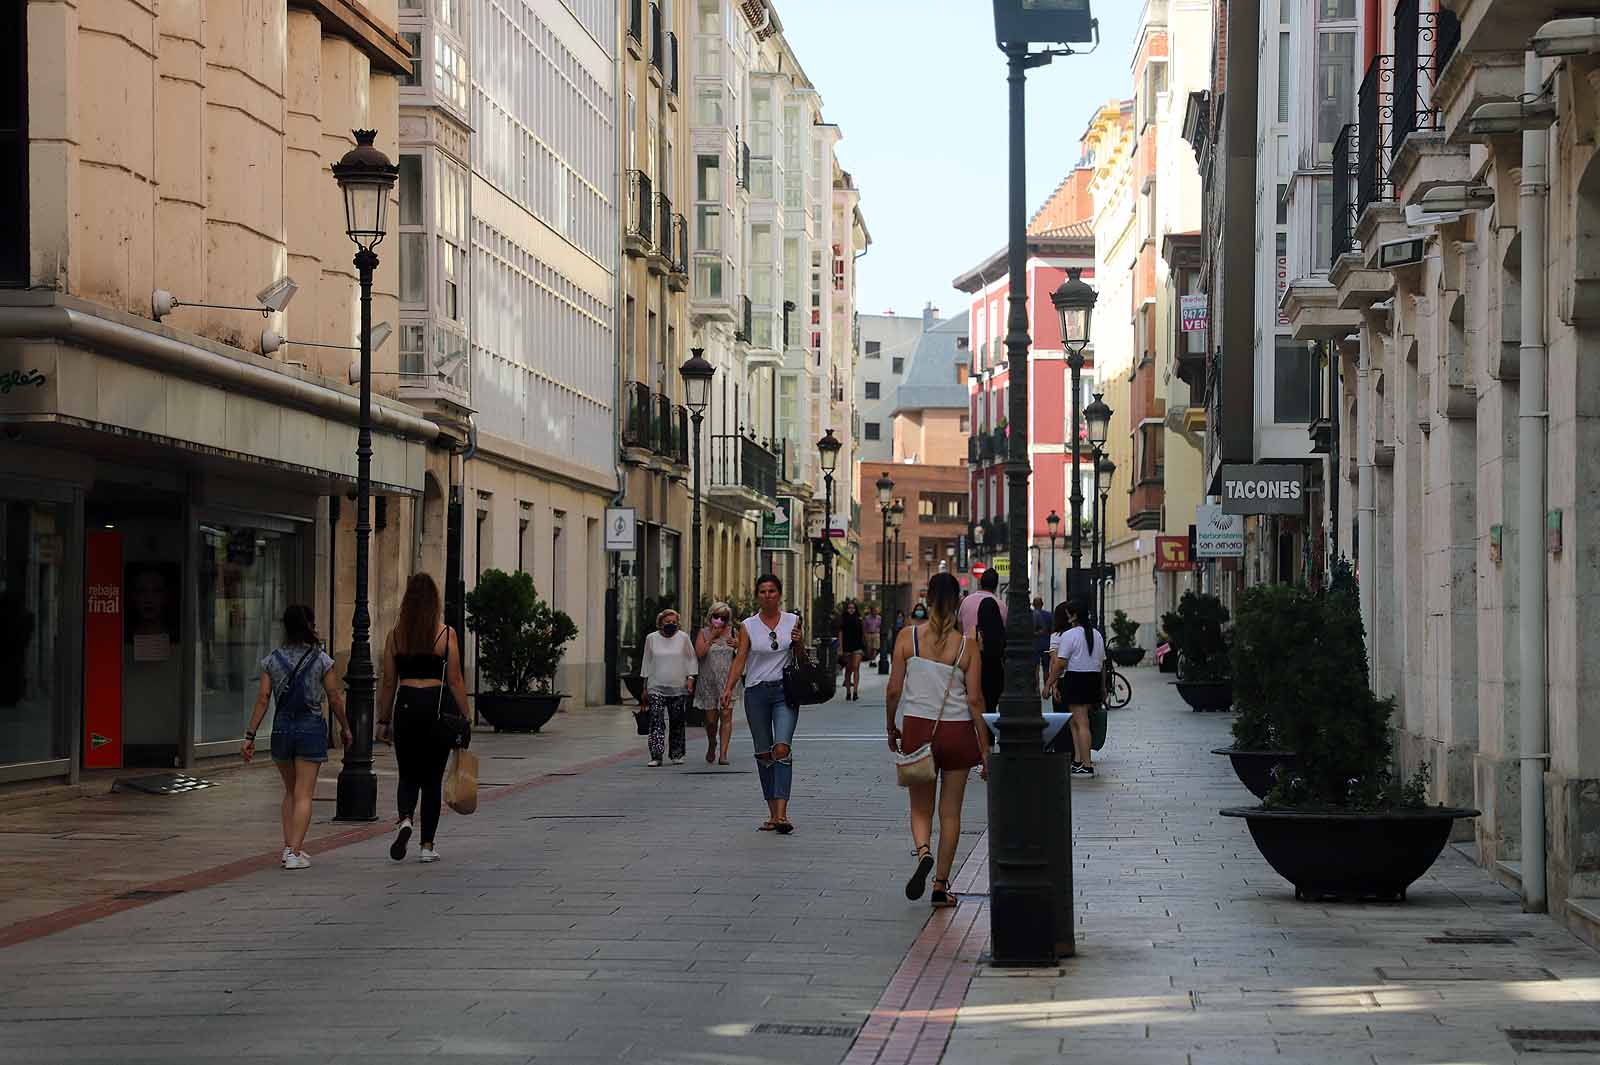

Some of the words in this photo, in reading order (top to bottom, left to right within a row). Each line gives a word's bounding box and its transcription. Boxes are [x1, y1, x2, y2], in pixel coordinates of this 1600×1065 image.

[1183, 310, 1197, 320] 947
[1225, 480, 1301, 499] TACONES
[1199, 541, 1214, 550] san
[1215, 541, 1243, 550] amaro
[88, 583, 121, 599] rebaja
[87, 595, 120, 614] final
